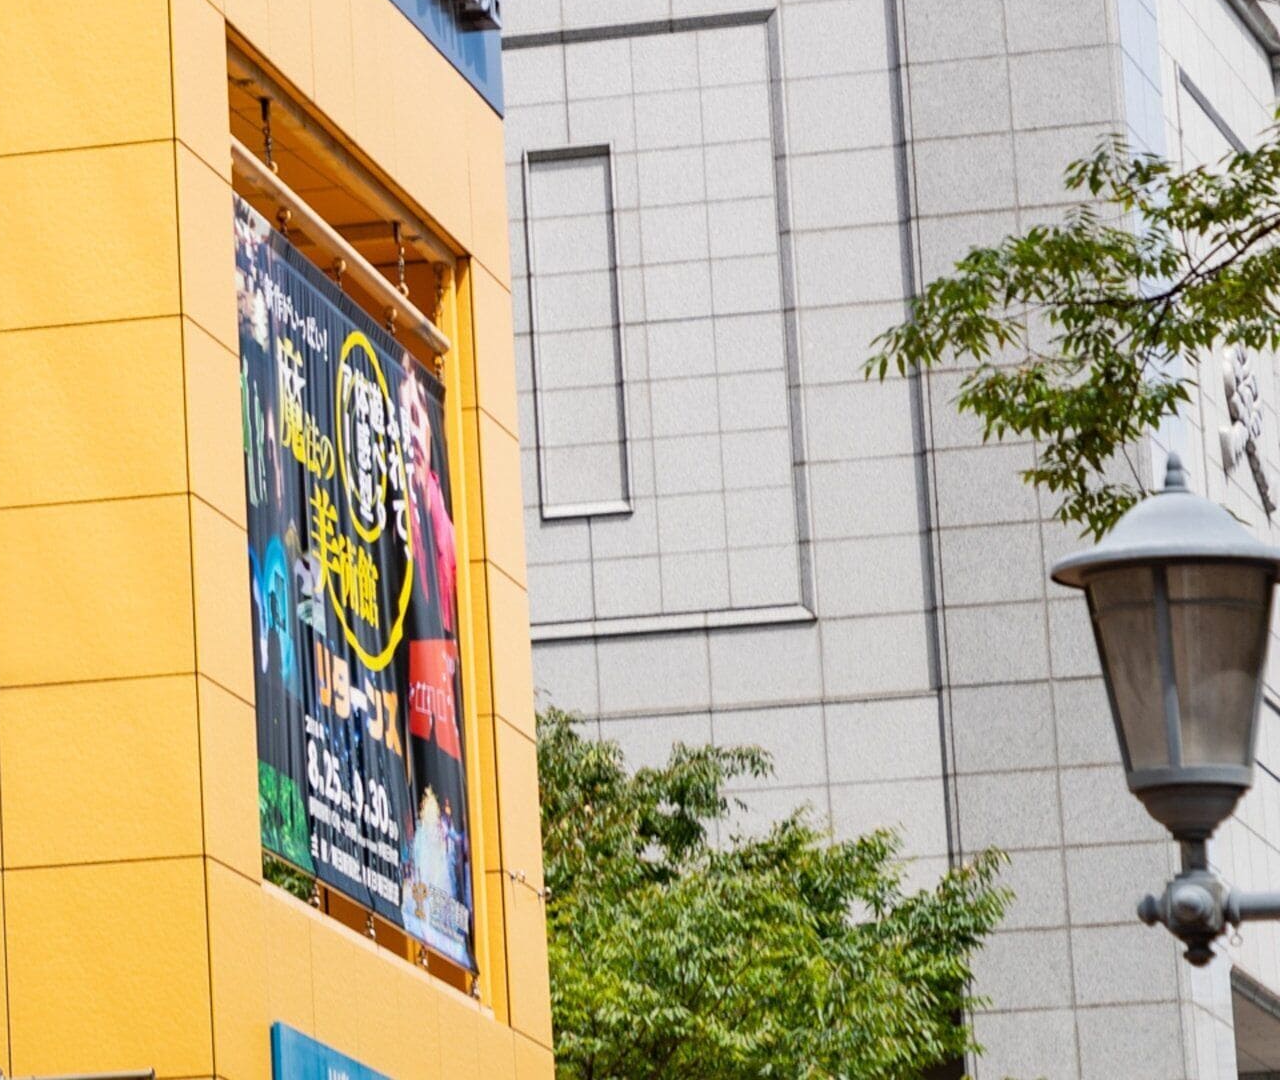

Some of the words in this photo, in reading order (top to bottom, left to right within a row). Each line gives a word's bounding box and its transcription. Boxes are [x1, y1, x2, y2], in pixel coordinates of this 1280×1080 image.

[276, 335, 335, 480] 魔法の
[309, 482, 380, 630] 美術館
